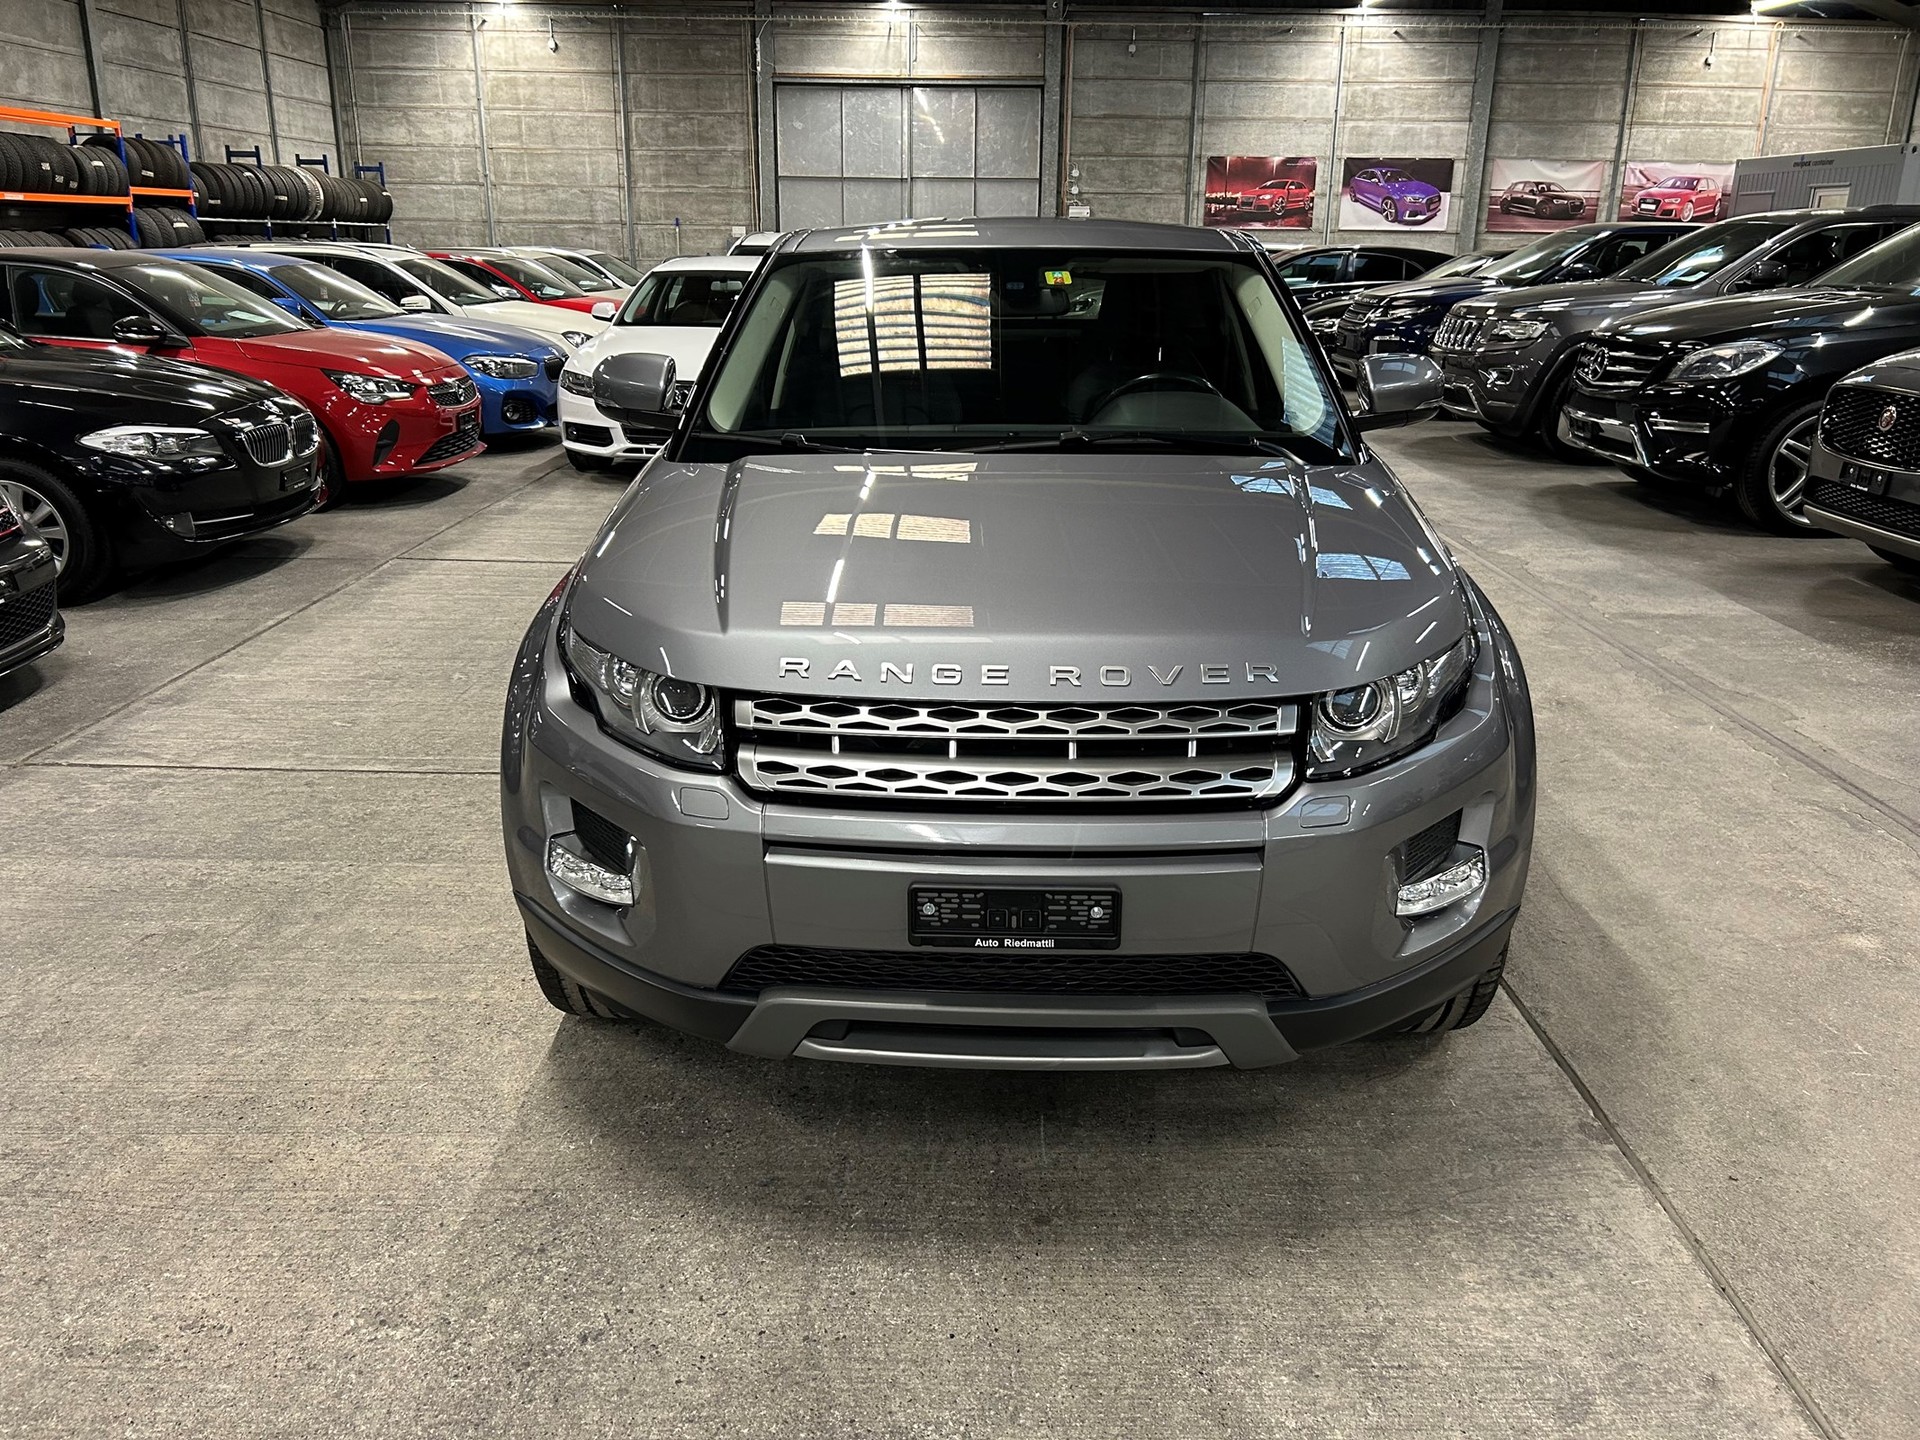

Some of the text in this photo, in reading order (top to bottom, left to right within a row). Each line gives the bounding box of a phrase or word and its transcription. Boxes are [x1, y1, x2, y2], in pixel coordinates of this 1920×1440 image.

[778, 656, 1280, 687] RANGE ROVER
[974, 938, 1055, 948] Auto Riedmattli
